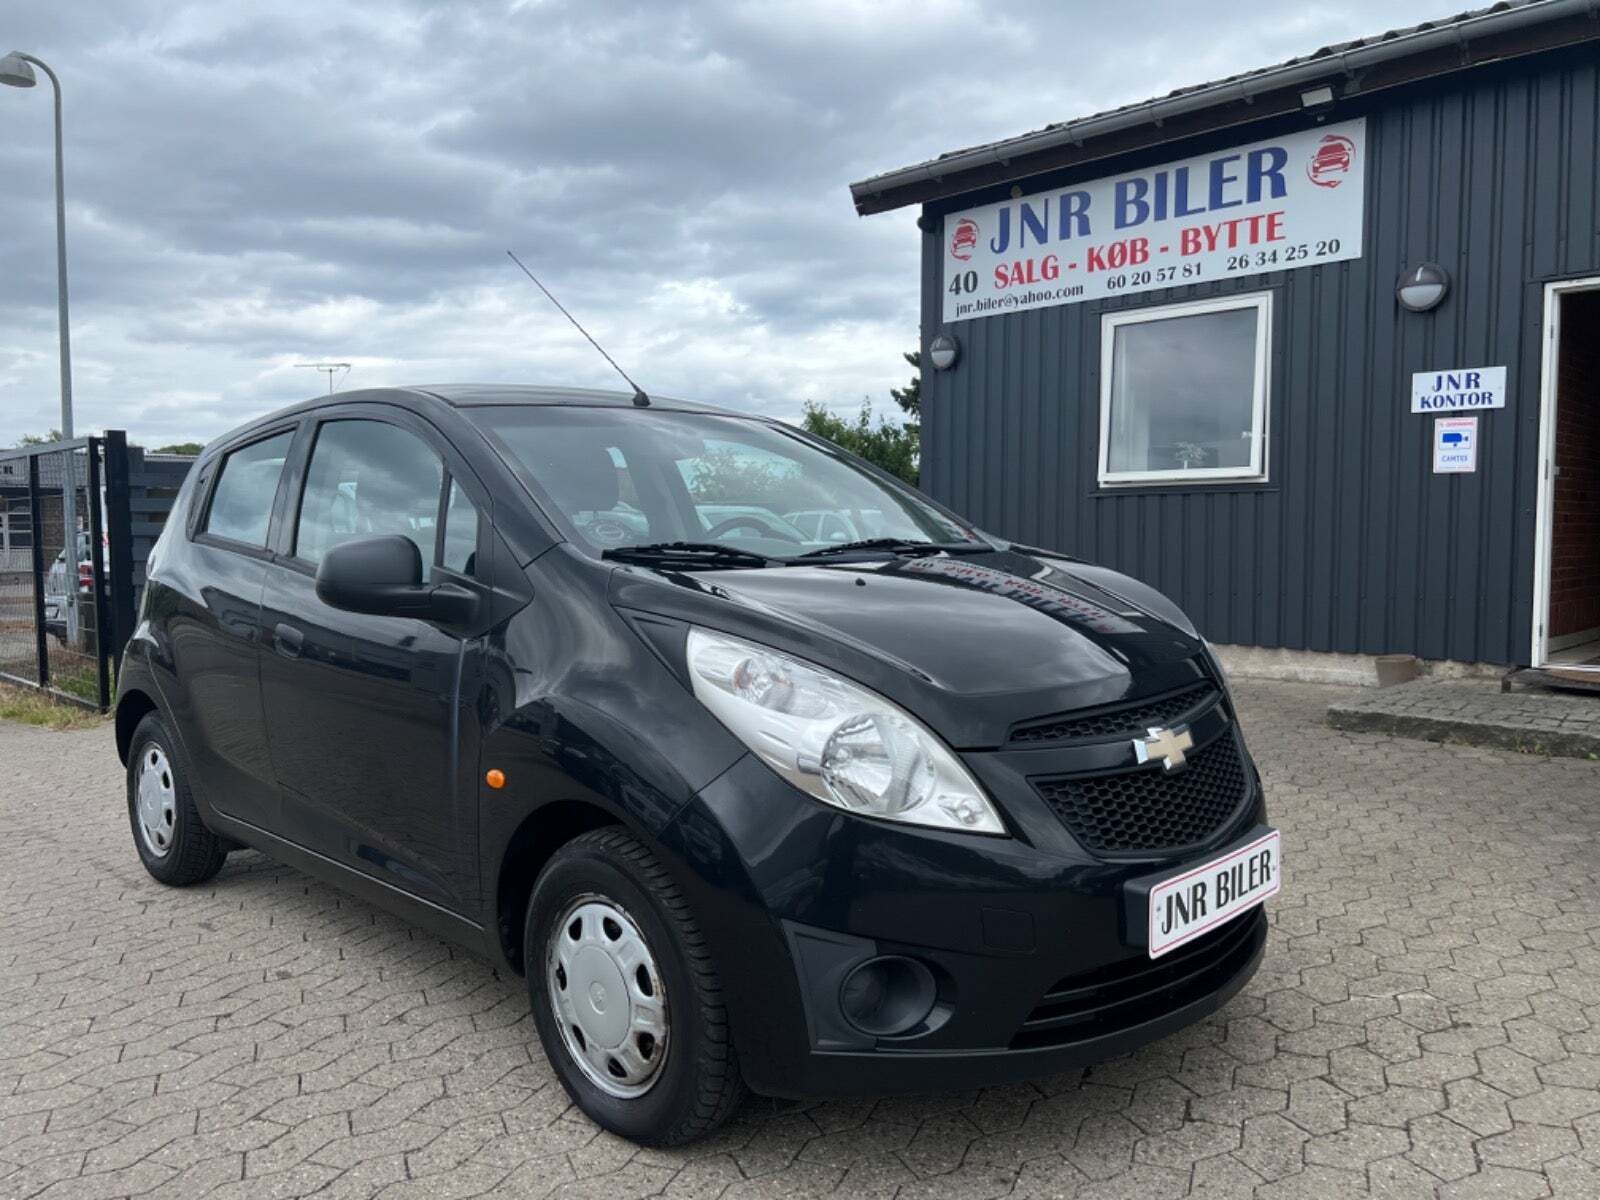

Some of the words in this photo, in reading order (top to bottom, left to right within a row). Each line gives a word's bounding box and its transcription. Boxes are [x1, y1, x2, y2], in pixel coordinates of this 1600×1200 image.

[990, 191, 1091, 255] JNR
[1114, 147, 1288, 230] BILER
[993, 255, 1059, 289] SALG
[1068, 262, 1077, 270] -
[1087, 237, 1149, 273] KØB
[1159, 245, 1169, 253] -
[1181, 211, 1286, 256] BYTTE
[1227, 255, 1249, 271] 26
[1255, 250, 1278, 267] 34
[1285, 244, 1308, 262] 25
[1316, 238, 1341, 256] 20
[949, 270, 978, 295] 40
[1107, 275, 1126, 290] 60
[1131, 271, 1151, 287] 20
[1156, 266, 1176, 282] 57
[1182, 262, 1201, 278] 81
[956, 284, 1084, 317] jnr.biler@yahoo.com
[1432, 372, 1480, 392] JNR
[1420, 392, 1493, 409] KONTOR
[1161, 882, 1207, 935] JNR
[1216, 849, 1271, 910] BILER
